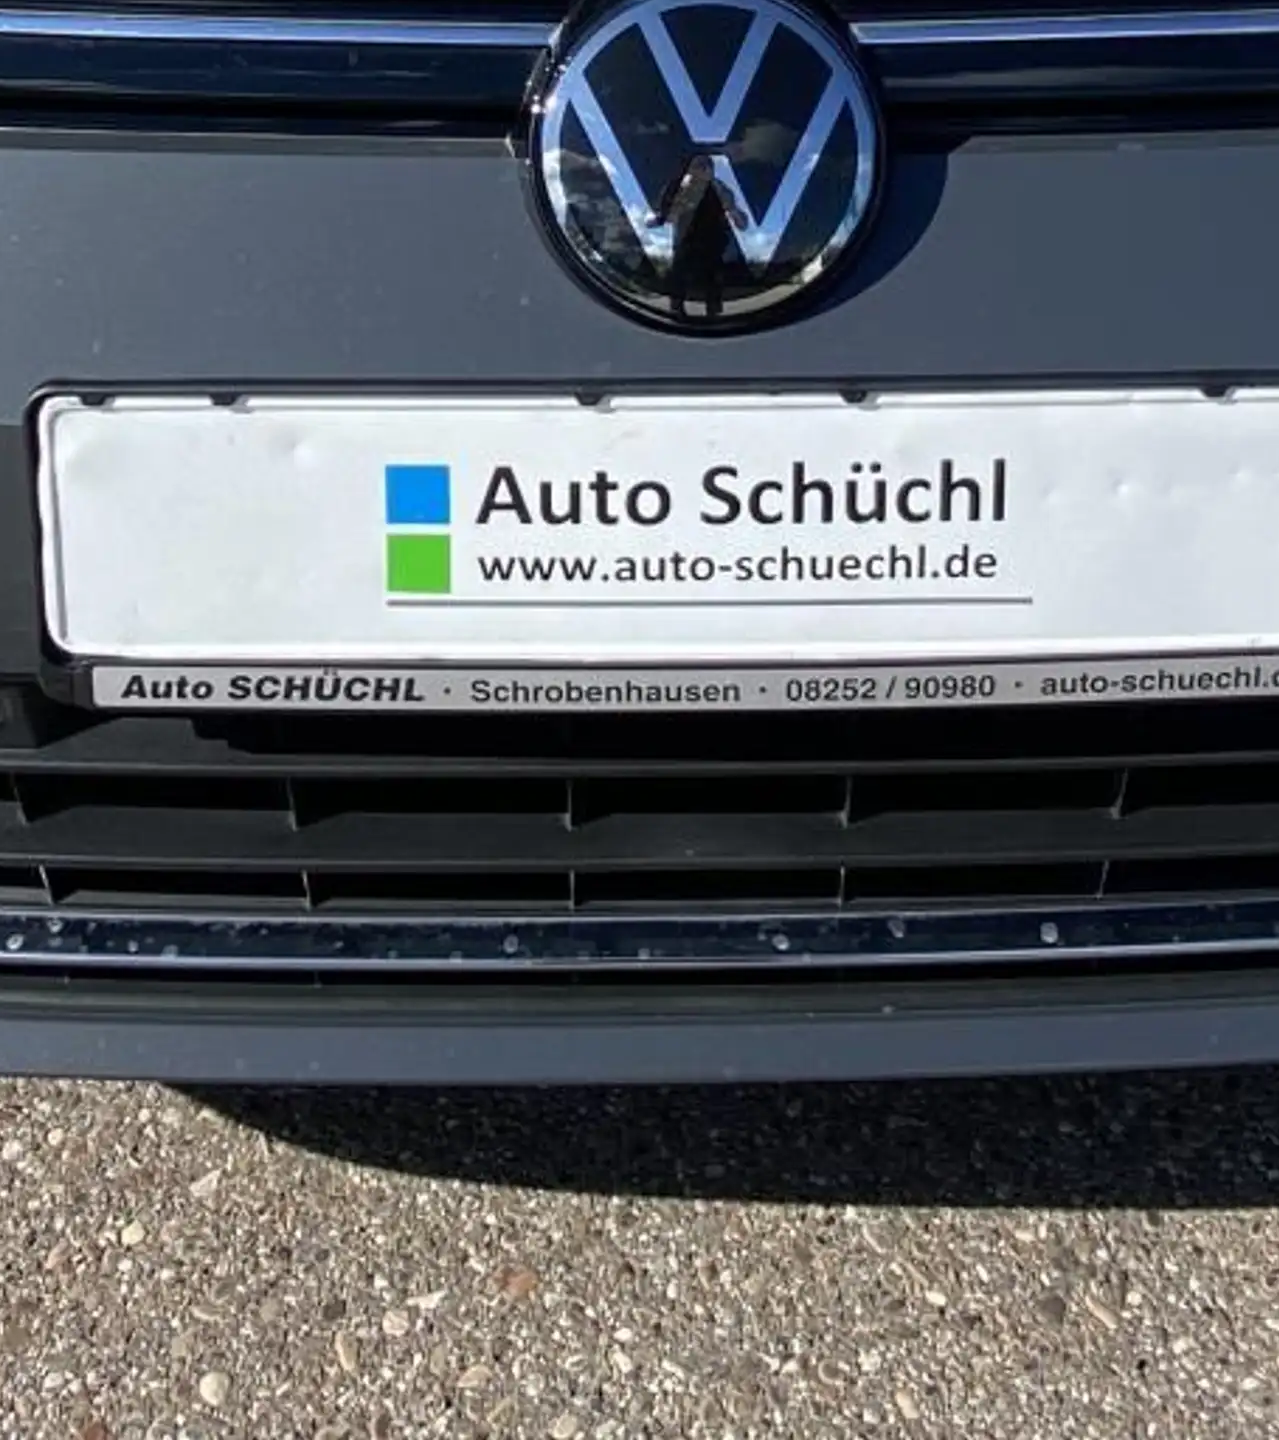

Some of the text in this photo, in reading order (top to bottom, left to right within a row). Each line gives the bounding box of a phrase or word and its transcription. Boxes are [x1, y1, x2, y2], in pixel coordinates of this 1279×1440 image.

[476, 458, 1006, 525] Auto Schüchl
[478, 543, 998, 582] www.auto-schuechl.de
[121, 675, 213, 700] Auto
[227, 668, 424, 702] SCHÜCHL
[471, 677, 740, 703] Schrobenhausen
[785, 677, 877, 701] 08252
[905, 675, 995, 699] 90980
